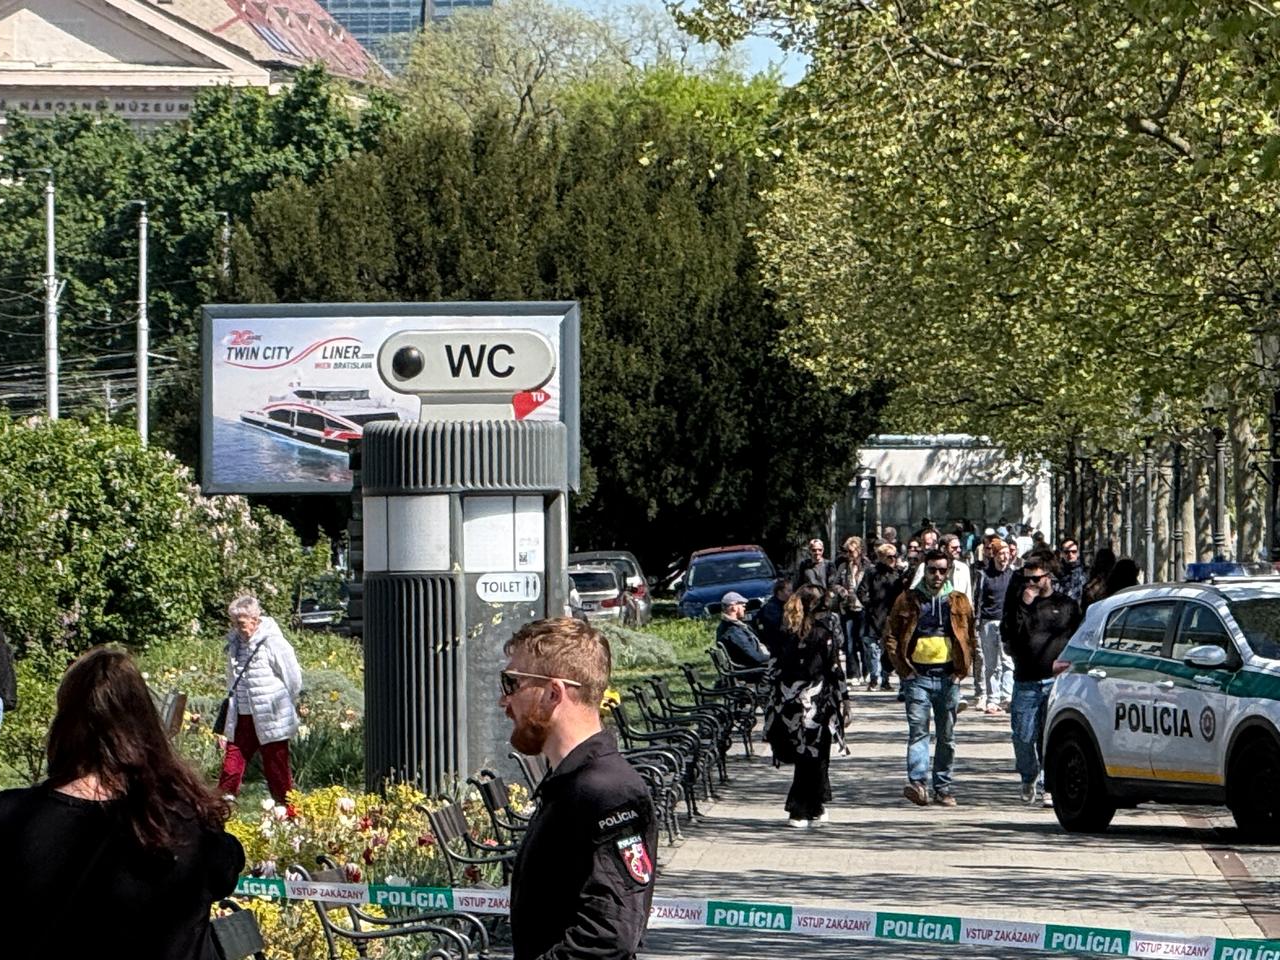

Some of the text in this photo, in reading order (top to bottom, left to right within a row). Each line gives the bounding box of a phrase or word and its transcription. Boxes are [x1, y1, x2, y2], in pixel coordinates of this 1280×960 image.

[227, 346, 260, 361] TWIN
[263, 346, 294, 360] CITY
[322, 345, 361, 359] LINER
[444, 343, 516, 378] WC
[481, 581, 521, 593] TOILET
[1114, 697, 1193, 738] POLÍCIA
[598, 809, 640, 829] POLÍCIA
[234, 879, 281, 896] LÍCIA
[290, 886, 318, 897] VSTUP
[376, 888, 449, 908] POLÍCIA
[458, 896, 486, 907] VSTUP
[714, 907, 786, 929] POLÍCIA
[797, 915, 824, 927] VSTUP
[883, 918, 955, 941] POLÍCIA
[966, 927, 993, 940] VSTUP
[1051, 930, 1124, 954] POLÍCIA
[1135, 941, 1162, 953] VSTUP
